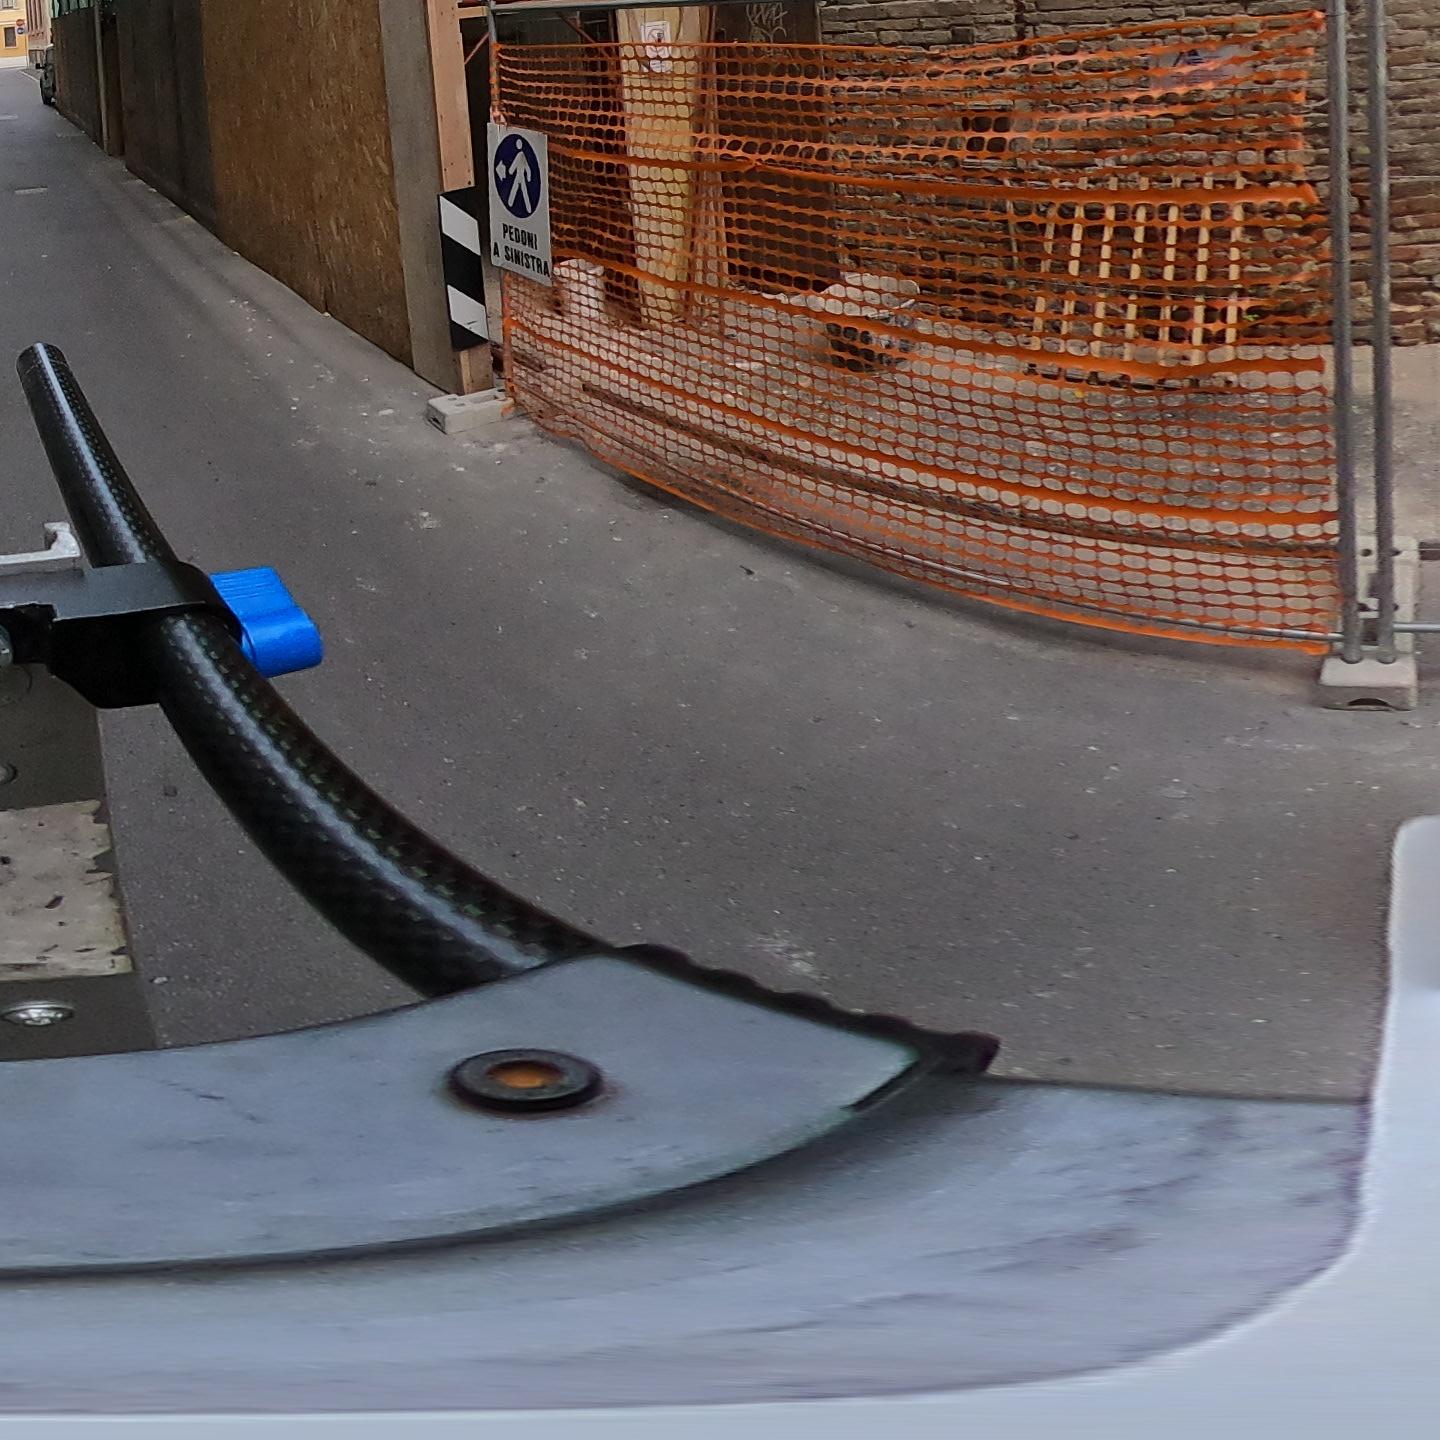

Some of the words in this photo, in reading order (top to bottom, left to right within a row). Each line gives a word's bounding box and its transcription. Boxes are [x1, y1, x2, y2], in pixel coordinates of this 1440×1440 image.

[502, 223, 538, 250] PEDONI
[493, 242, 500, 258] A
[504, 245, 551, 277] SINISTRA
